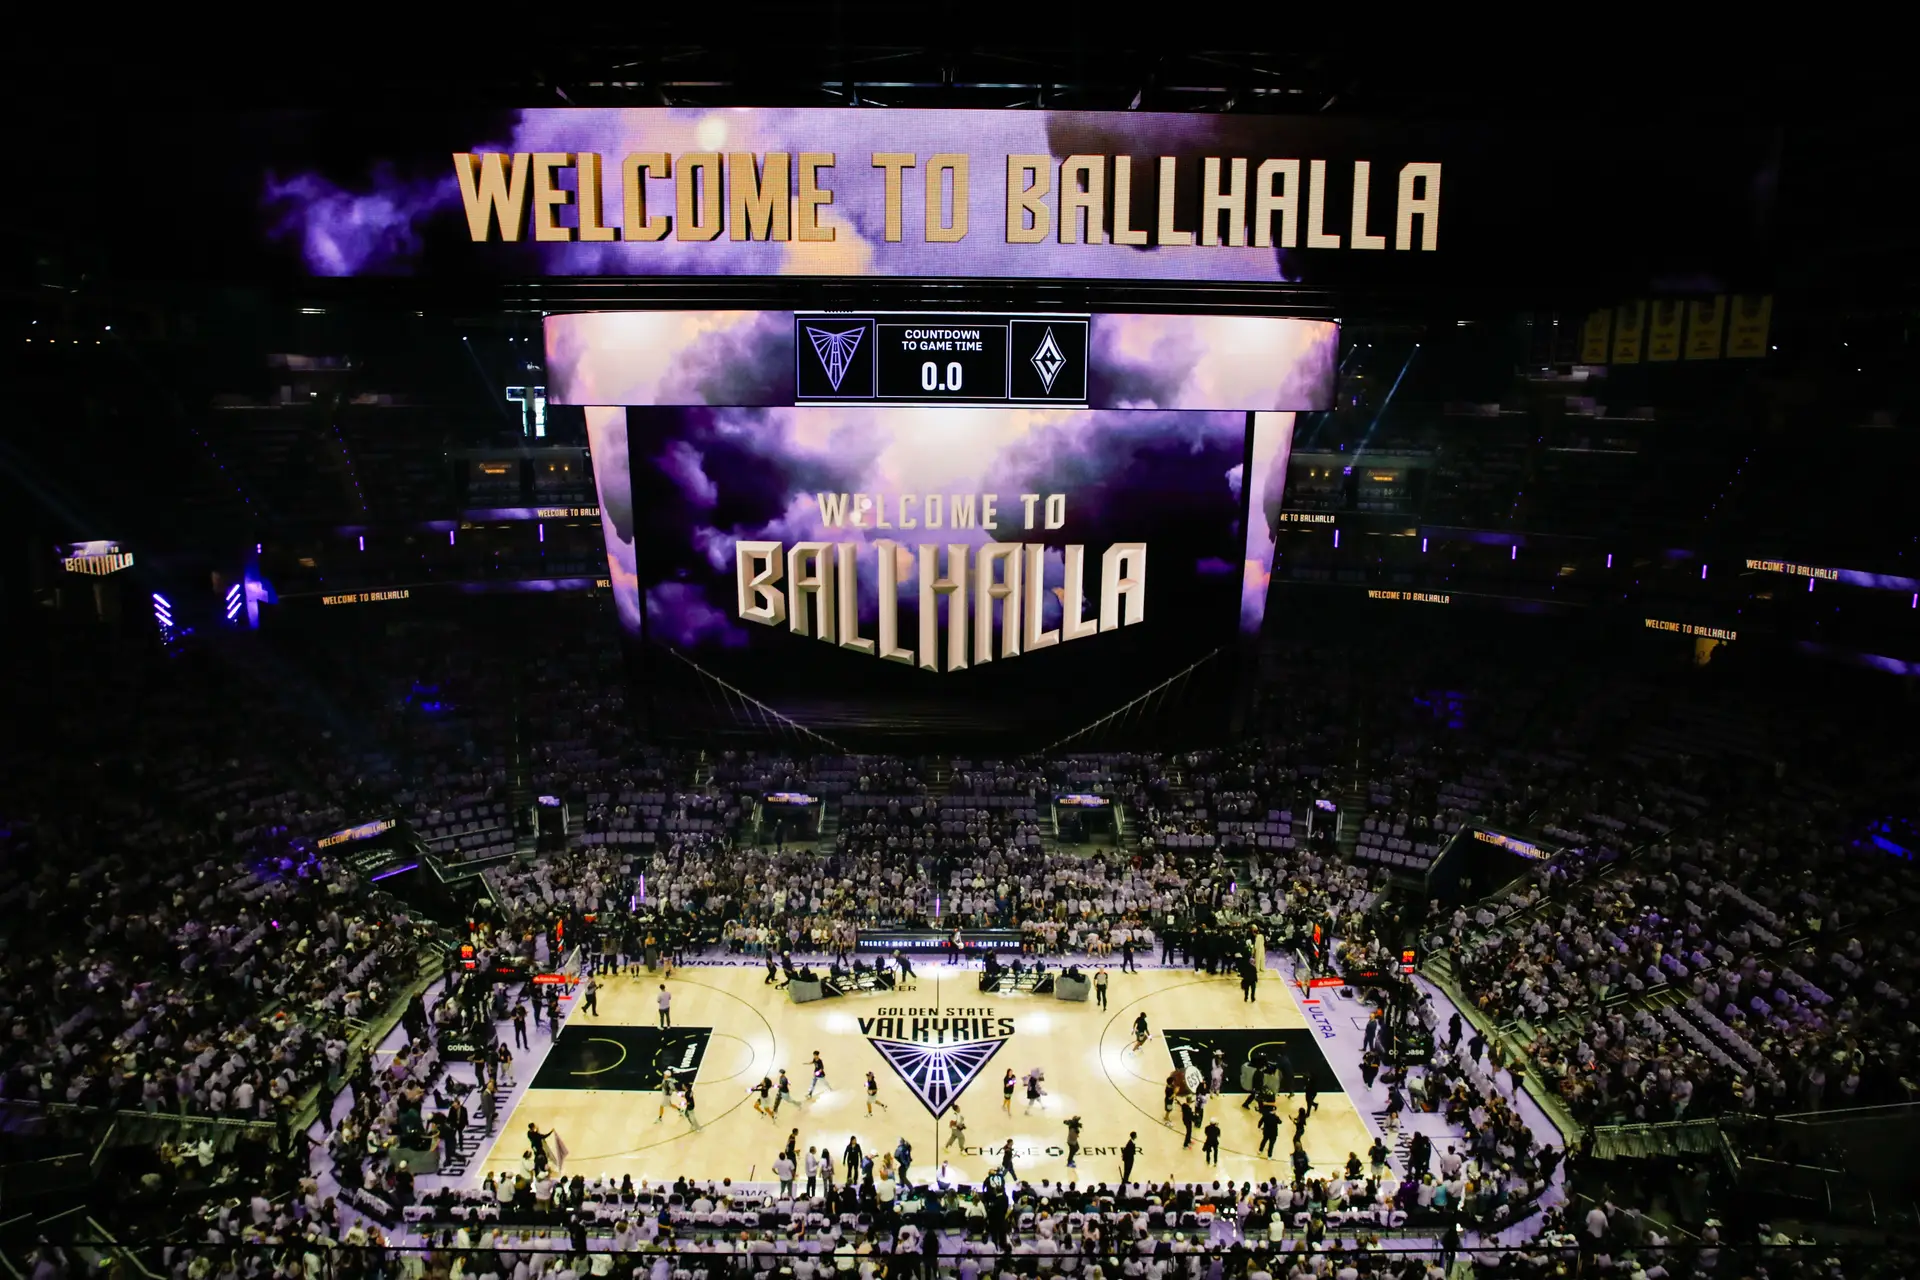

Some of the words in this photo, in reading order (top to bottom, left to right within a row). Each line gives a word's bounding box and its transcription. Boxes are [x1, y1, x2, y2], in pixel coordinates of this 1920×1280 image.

[452, 151, 836, 242] WELCOME
[871, 152, 969, 242] TO
[1005, 154, 1442, 251] BALLHALLA
[905, 329, 980, 340] COUNTDOWN
[902, 341, 917, 351] TO
[920, 341, 953, 351] GAME
[955, 342, 983, 351] TIME
[922, 361, 963, 391] 0.0
[537, 509, 568, 517] WELCOME
[570, 508, 579, 517] TO
[817, 492, 998, 530] WELCOME
[1020, 493, 1066, 530] TO
[1290, 514, 1298, 522] TO
[1300, 514, 1335, 524] BALLHALLA
[1746, 559, 1784, 572] WELCOME
[1786, 564, 1795, 574] TO
[1797, 565, 1838, 580] BALLHALLA
[596, 580, 611, 588] WEL
[322, 594, 357, 605] WELCOME
[359, 593, 369, 602] TO
[370, 589, 409, 601] BALLHALLA
[1368, 590, 1400, 600] WELCOME
[1402, 591, 1411, 600] TO
[1413, 592, 1450, 604] BALLHALLA
[736, 540, 1147, 673] BALLHALLA
[1645, 618, 1679, 632] WELCOME
[1682, 623, 1692, 634] TO
[1694, 625, 1737, 640] BALLHALLA
[878, 1007, 939, 1016] GOLDEN
[946, 1007, 994, 1016] STATE
[857, 1017, 1015, 1044] VALKYRIES
[1308, 1006, 1336, 1039] ULTRA
[964, 1147, 1040, 1156] CHE
